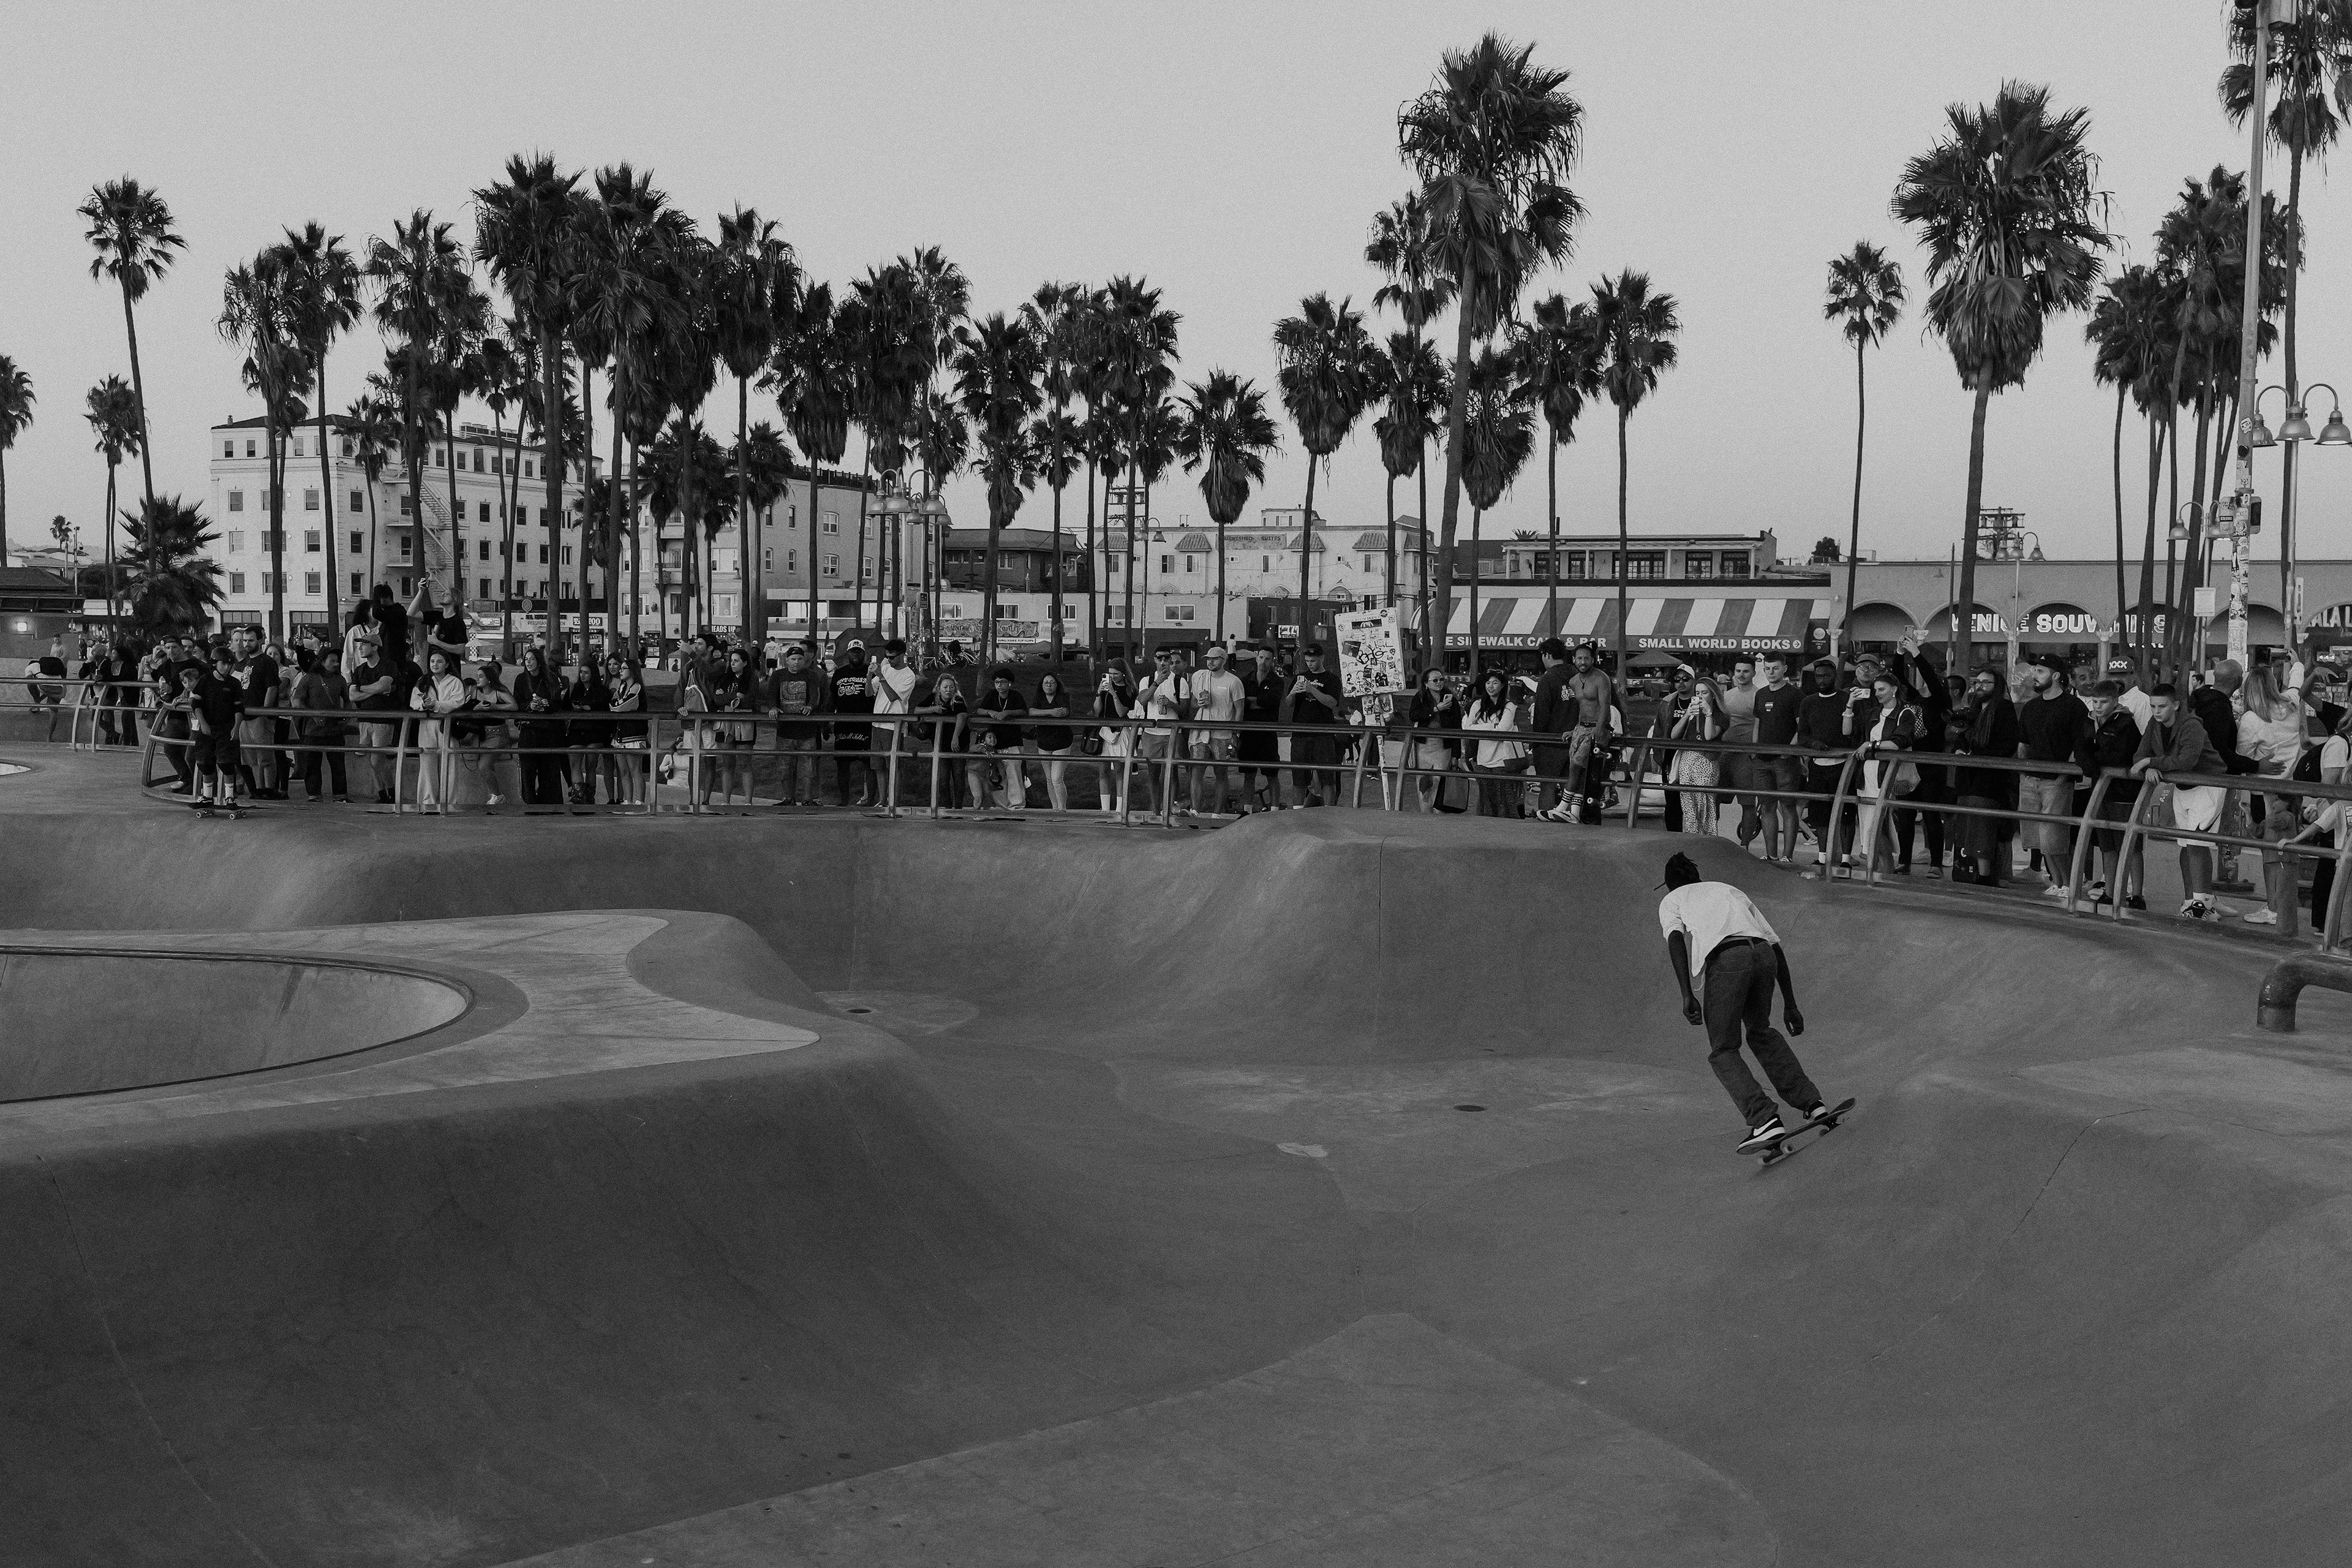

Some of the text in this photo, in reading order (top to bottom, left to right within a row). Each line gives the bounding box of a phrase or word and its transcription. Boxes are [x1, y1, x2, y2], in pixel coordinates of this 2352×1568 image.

[1457, 636, 1523, 646] SIEWALK
[1638, 638, 1790, 649] SMALL WORLD BOOKS
